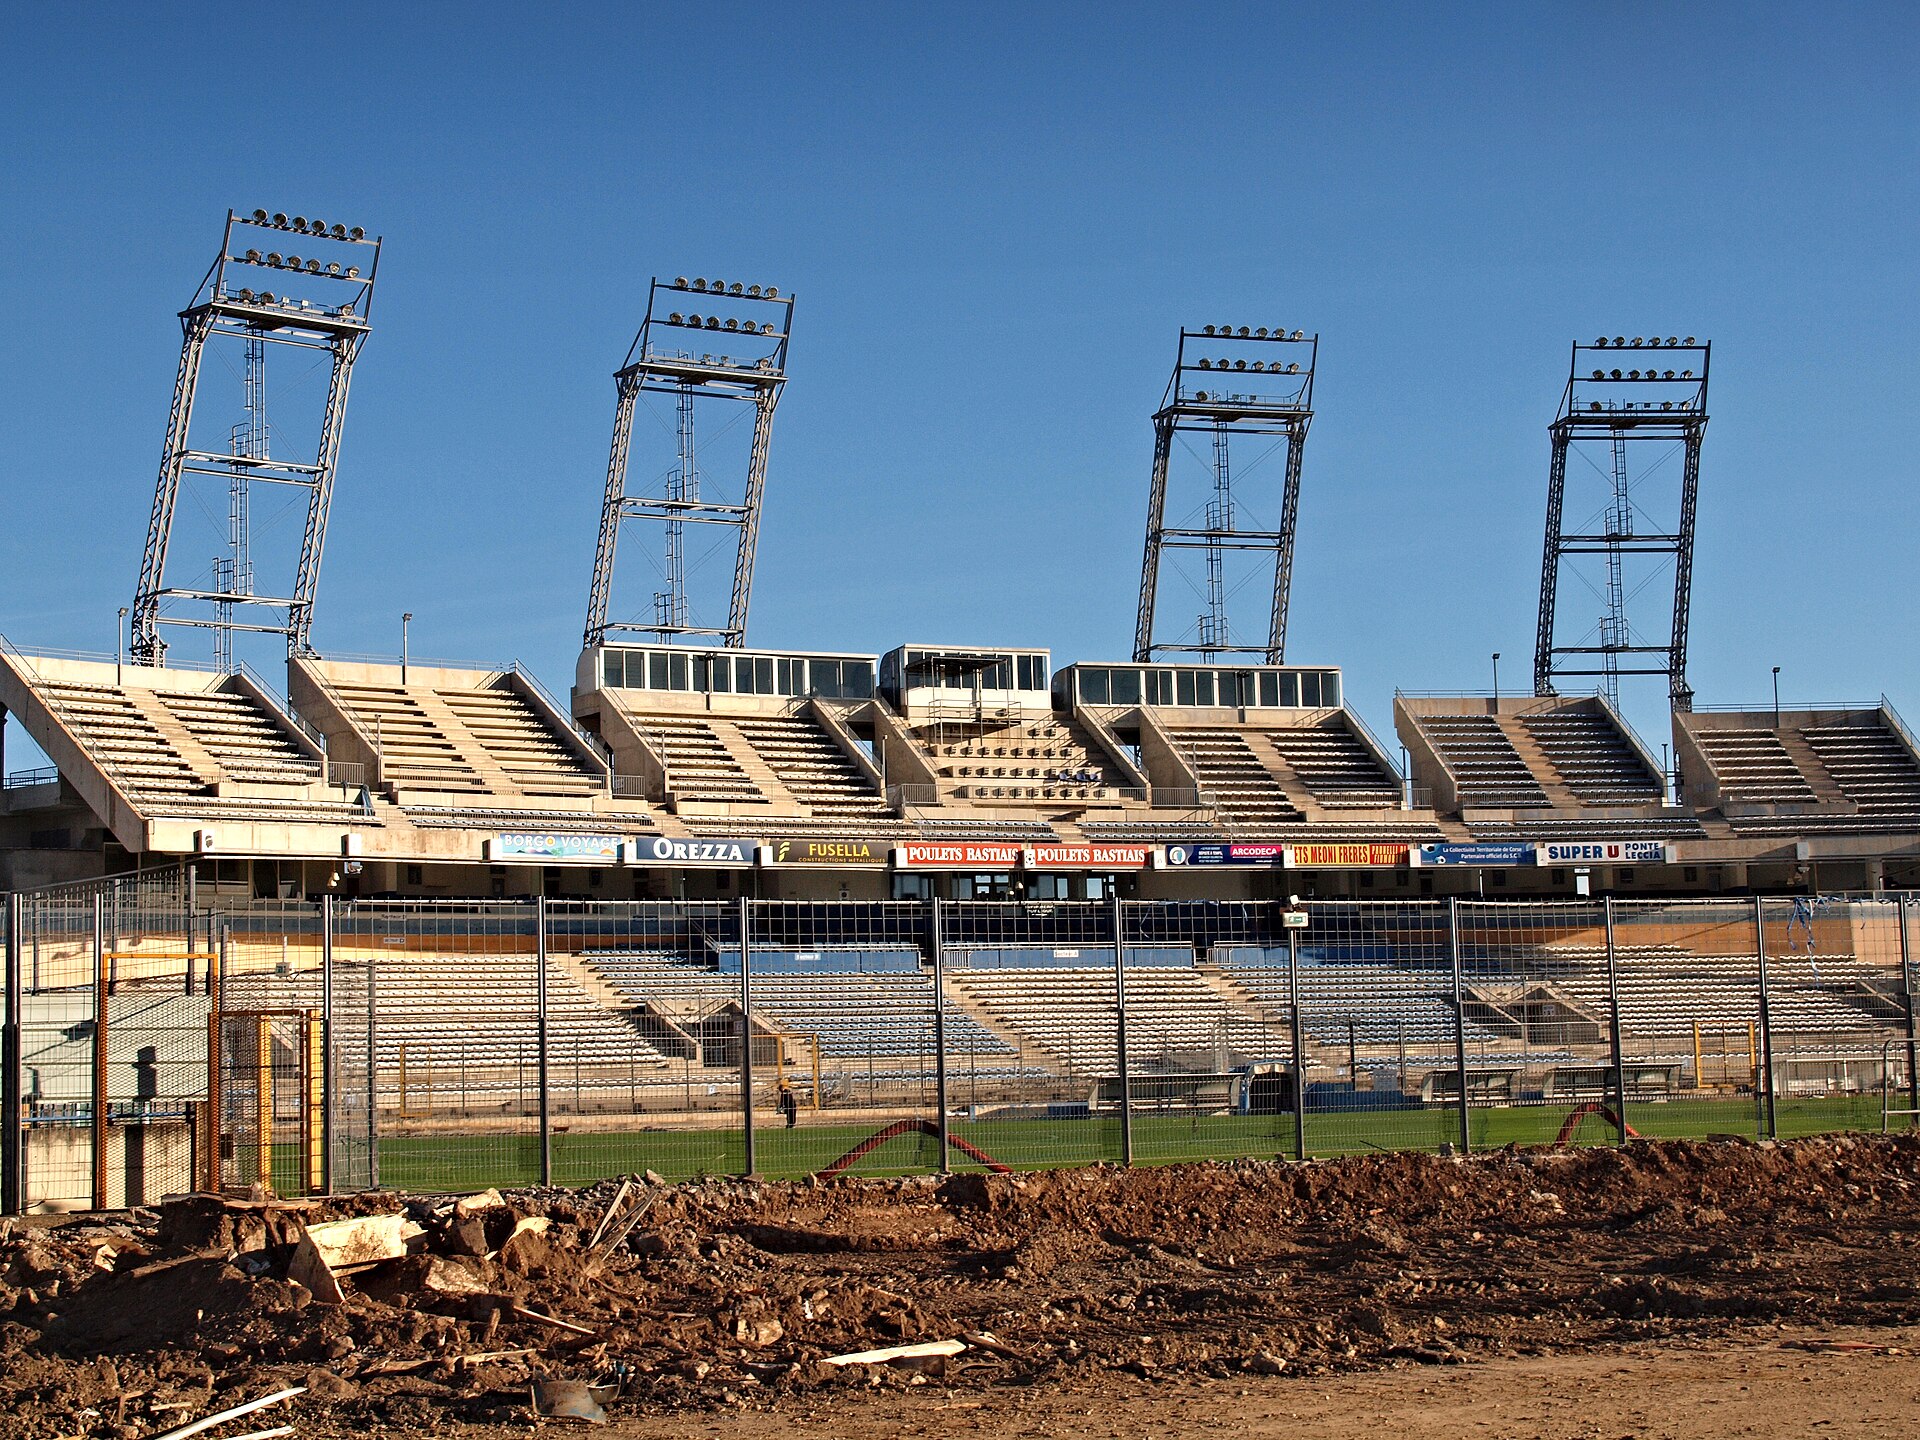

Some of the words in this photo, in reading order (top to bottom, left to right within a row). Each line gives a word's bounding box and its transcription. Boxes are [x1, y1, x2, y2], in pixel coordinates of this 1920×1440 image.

[505, 834, 556, 847] BORGO
[1625, 842, 1660, 851] PONTE
[653, 837, 744, 861] OREZZA
[809, 843, 870, 857] FUSELLA
[908, 846, 963, 861] POULETS
[965, 847, 1019, 862] BASTIAIS
[1036, 848, 1091, 862] POULETS
[1092, 848, 1145, 863] BASTIAIS
[1232, 847, 1278, 856] ARCODECA
[1294, 845, 1309, 864] ETS
[1310, 845, 1337, 864] MEONI
[1339, 845, 1368, 864] FRERES
[1548, 845, 1603, 859] SUPER
[1607, 845, 1620, 858] U
[1625, 851, 1661, 860] LECCIA
